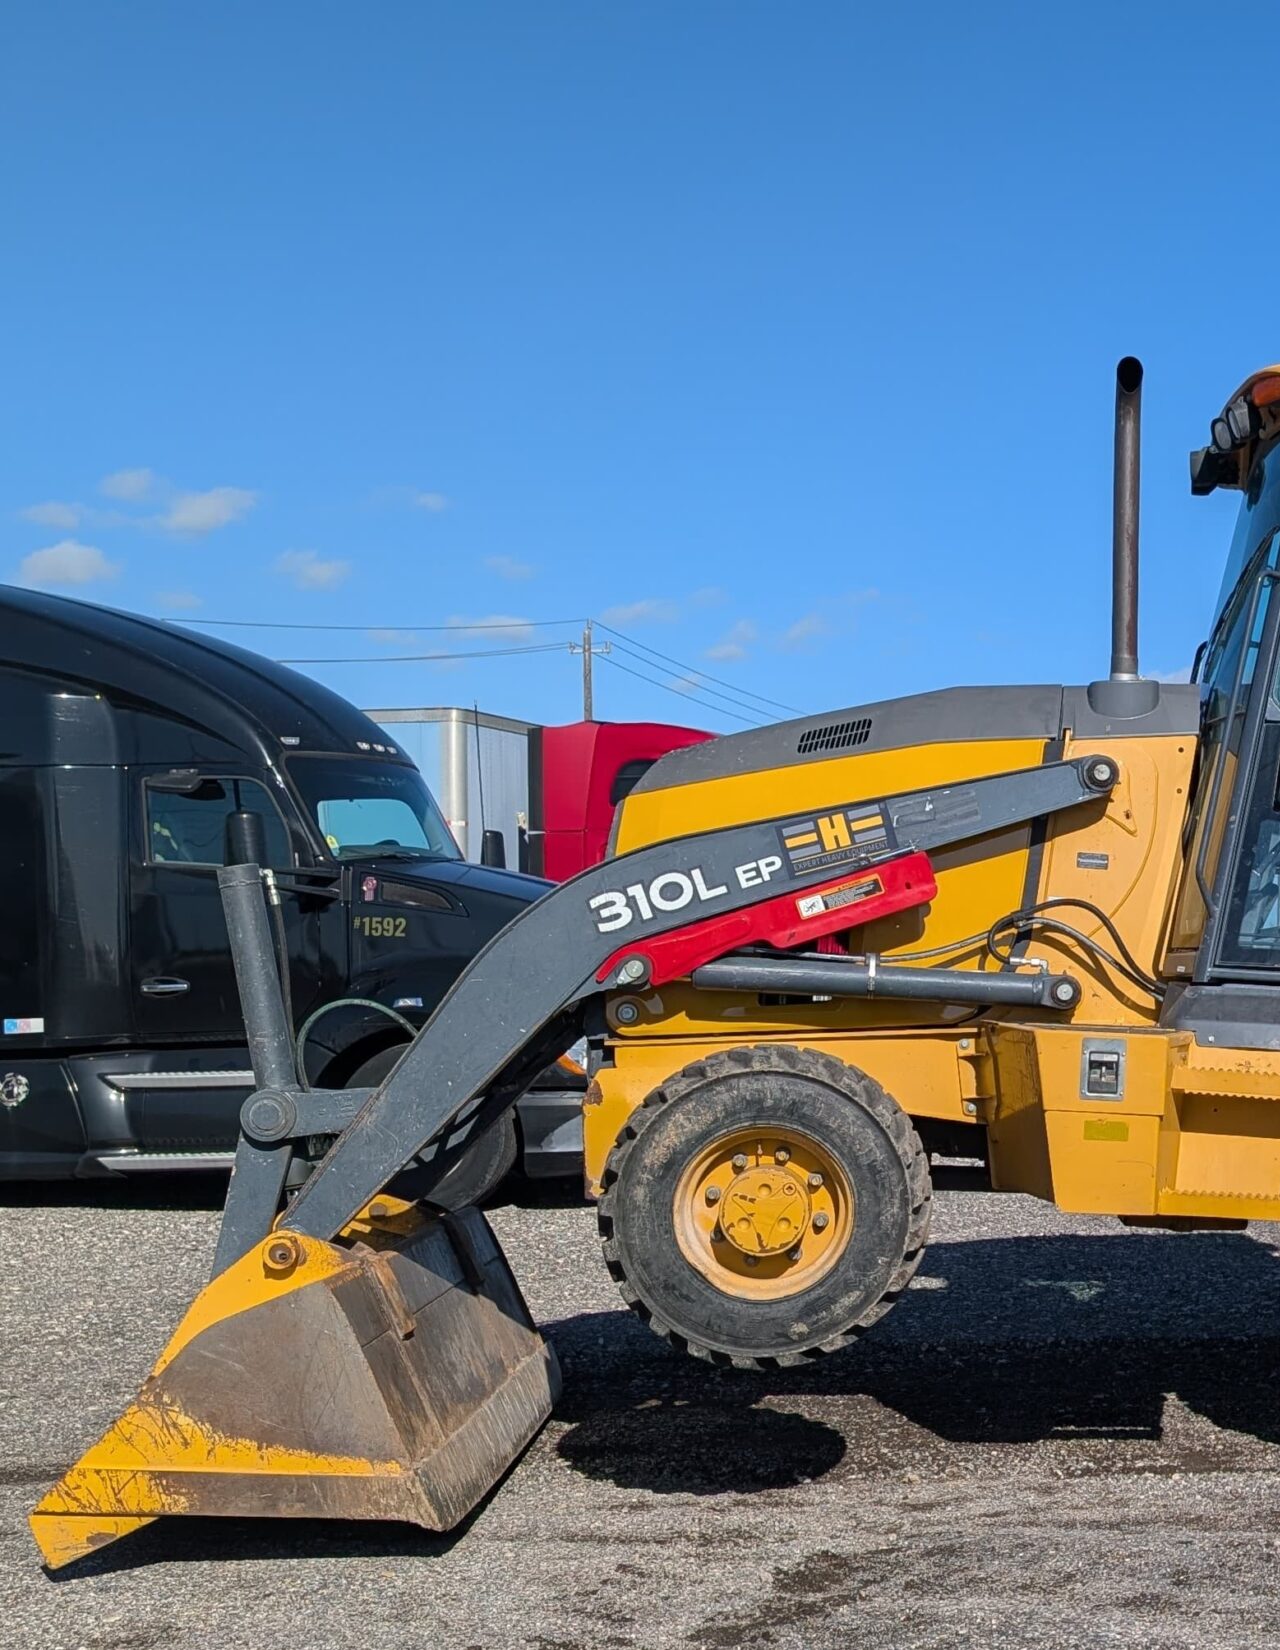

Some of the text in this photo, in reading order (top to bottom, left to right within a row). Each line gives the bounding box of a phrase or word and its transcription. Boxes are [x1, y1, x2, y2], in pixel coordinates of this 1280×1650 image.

[793, 840, 889, 873] EXPERT HEAVY EQUIPMENT
[589, 855, 782, 933] 310L EP
[353, 916, 407, 937] #1592
